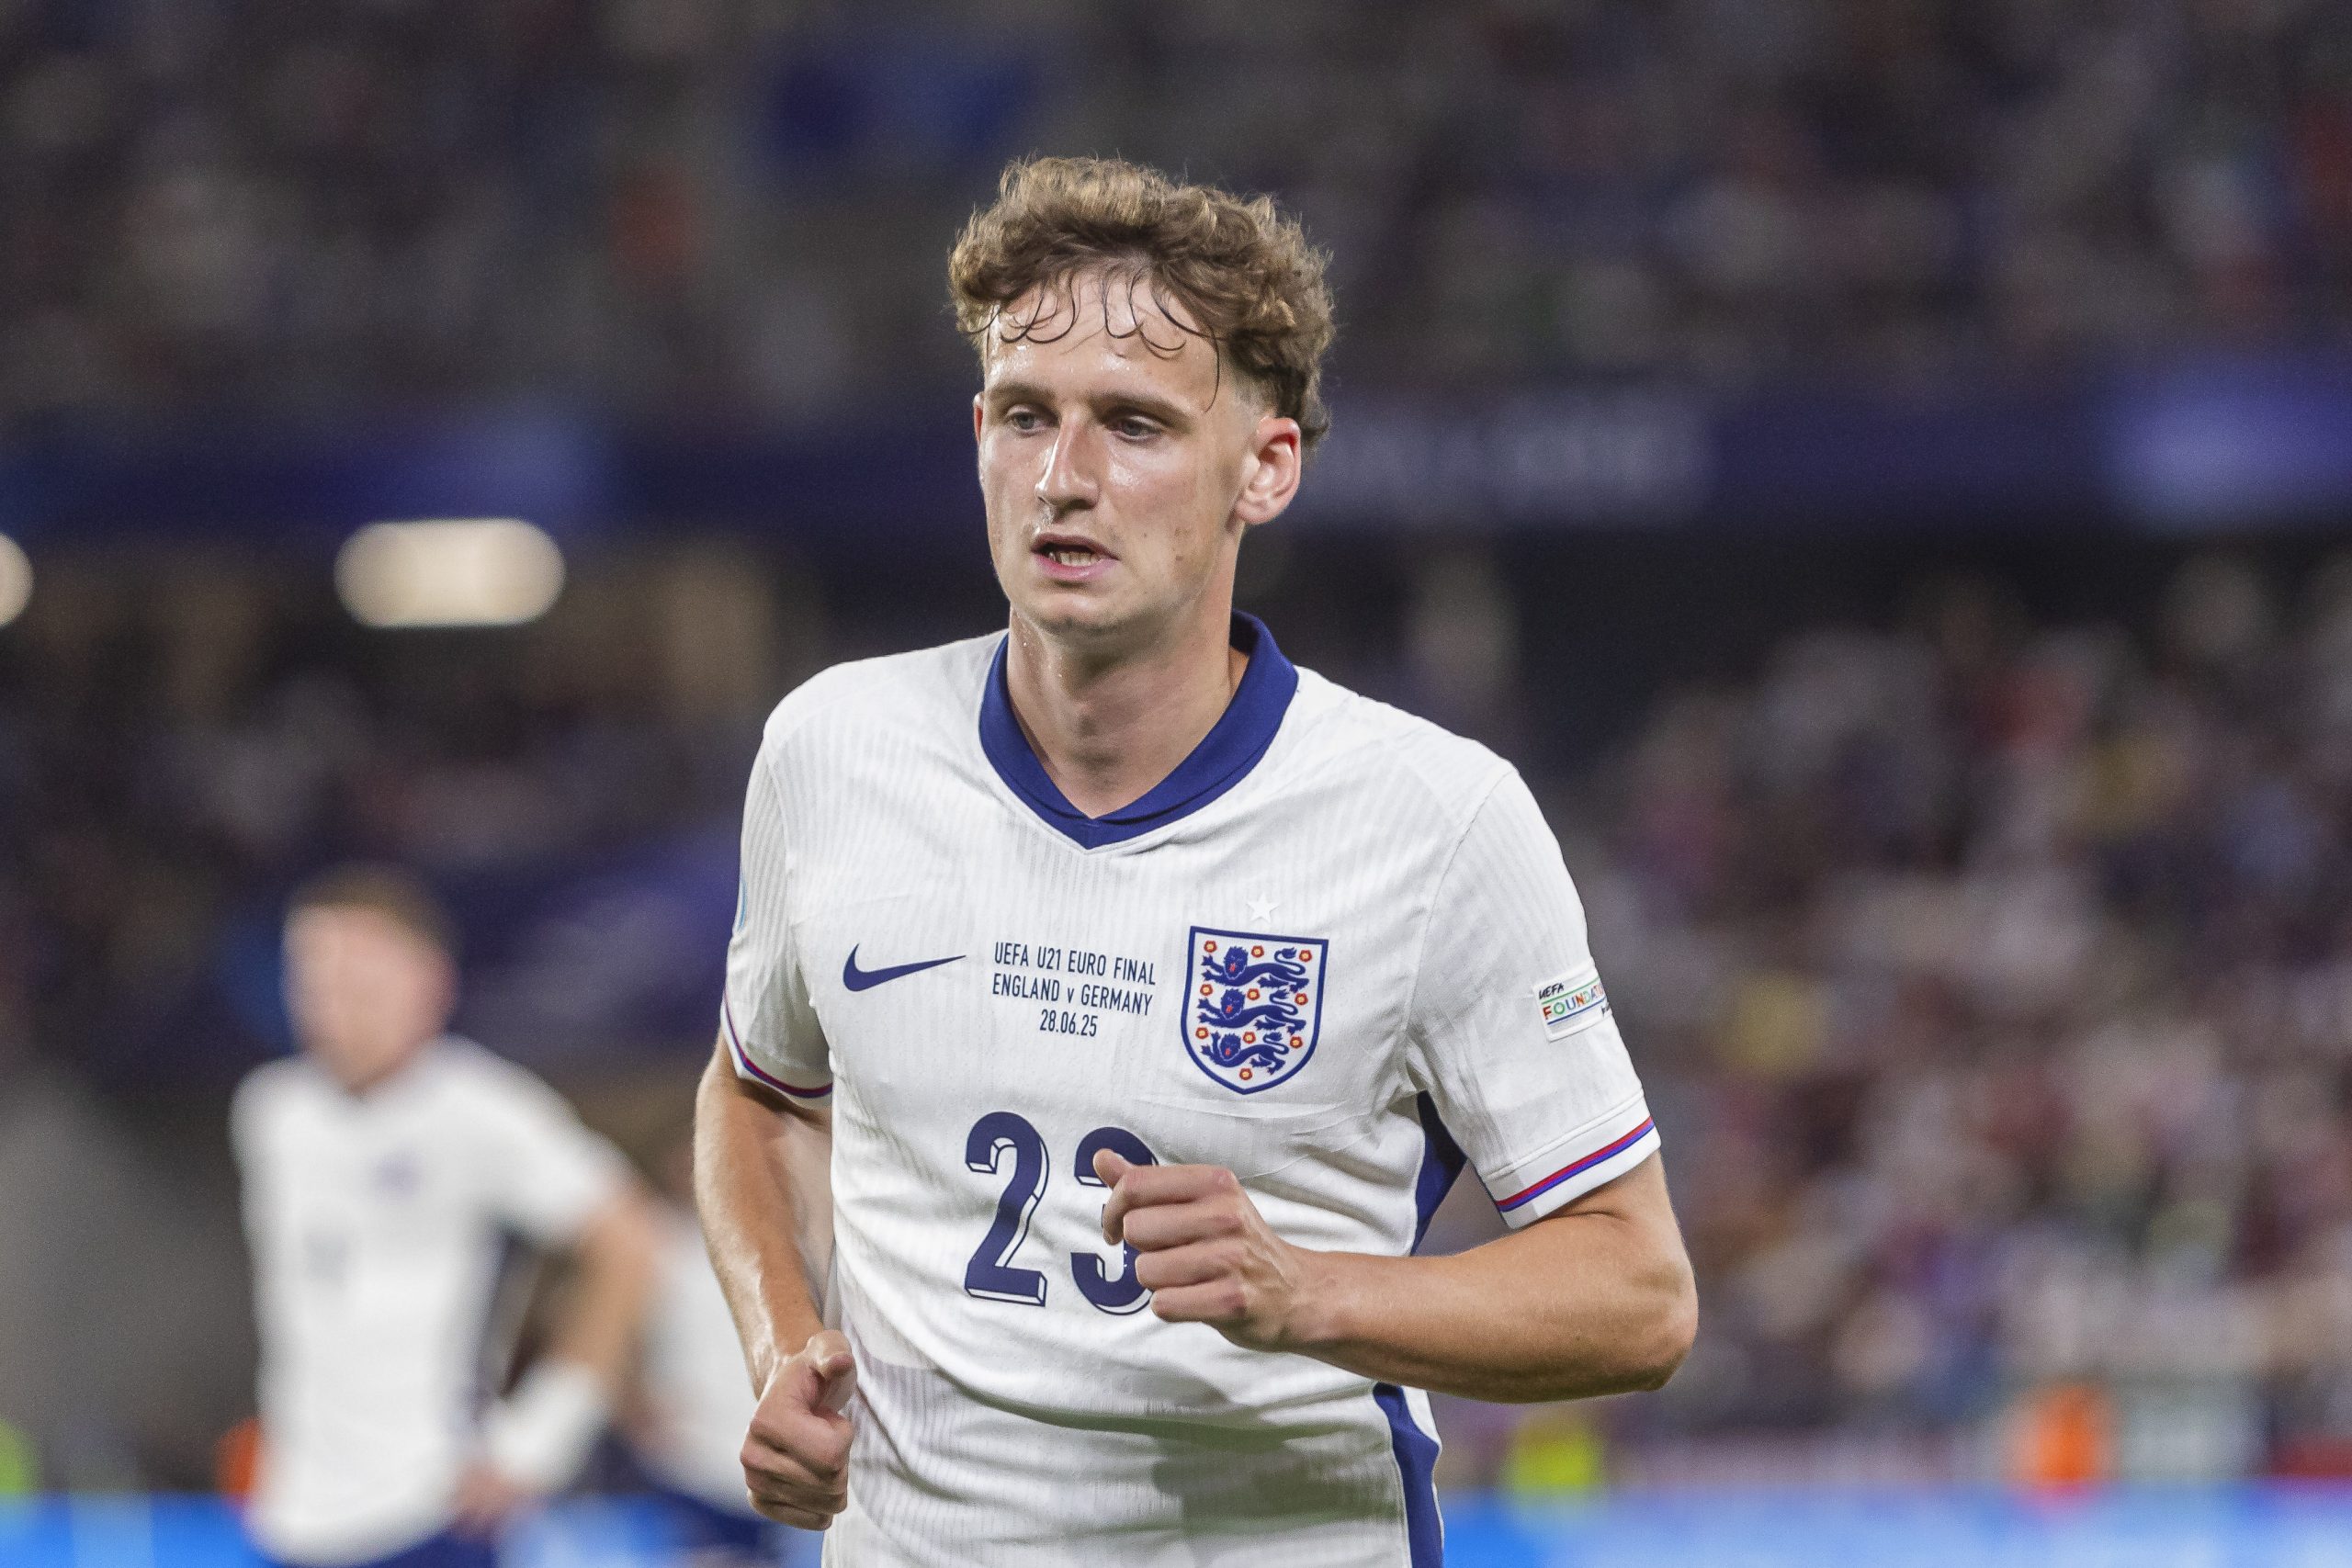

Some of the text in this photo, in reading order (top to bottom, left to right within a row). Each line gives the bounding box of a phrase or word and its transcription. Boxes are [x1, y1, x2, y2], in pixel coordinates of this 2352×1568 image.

[994, 942, 1156, 986] UEFA U21 EURO FINAL
[992, 973, 1153, 1016] ENGLAND v GERMANY
[1539, 983, 1564, 999] UEFA
[1039, 1009, 1098, 1037] 28.06.25
